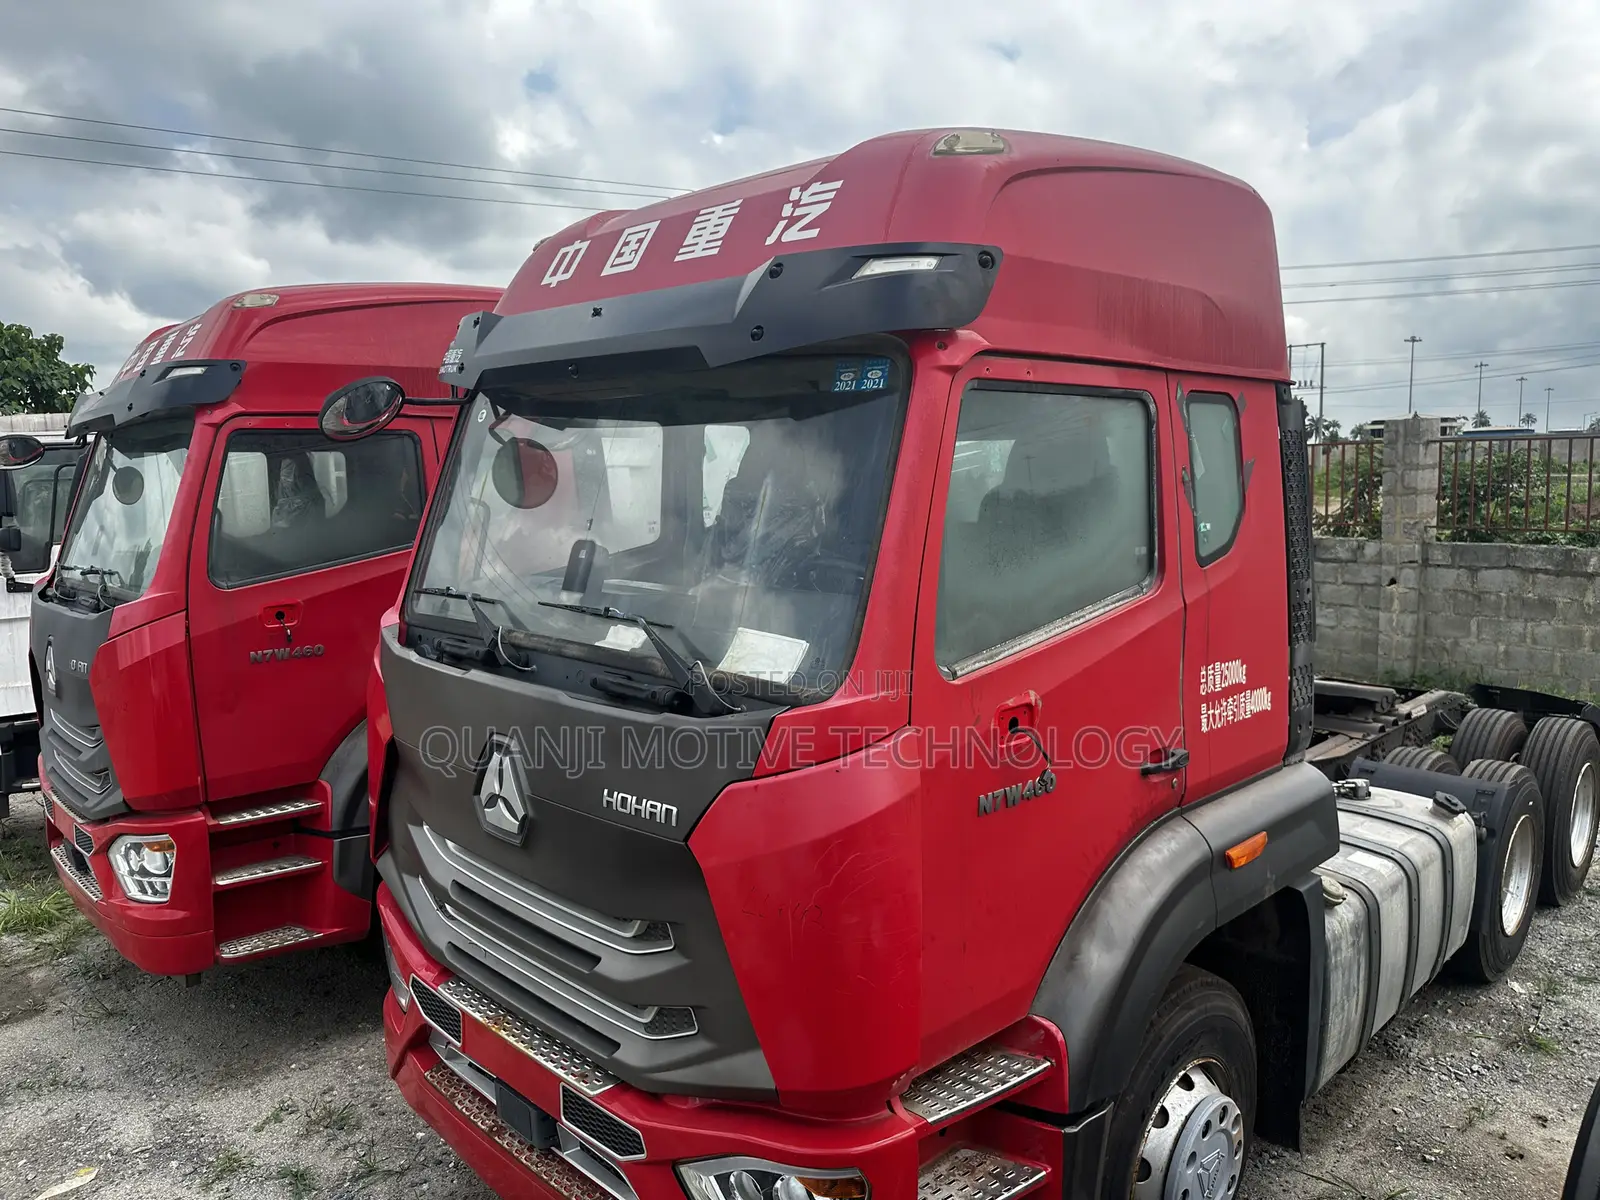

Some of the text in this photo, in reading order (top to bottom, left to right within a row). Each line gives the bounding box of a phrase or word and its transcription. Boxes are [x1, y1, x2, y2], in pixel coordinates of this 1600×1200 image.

[541, 180, 844, 288] 中国重汽
[834, 380, 857, 392] 2021
[861, 378, 885, 390] 2021
[249, 643, 325, 664] N7W460
[1200, 659, 1247, 696] 总质量25000kg
[1200, 686, 1272, 733] 最大允许牵引质量40000kg
[602, 788, 678, 827] HOHAN
[977, 769, 1057, 818] N7W460
